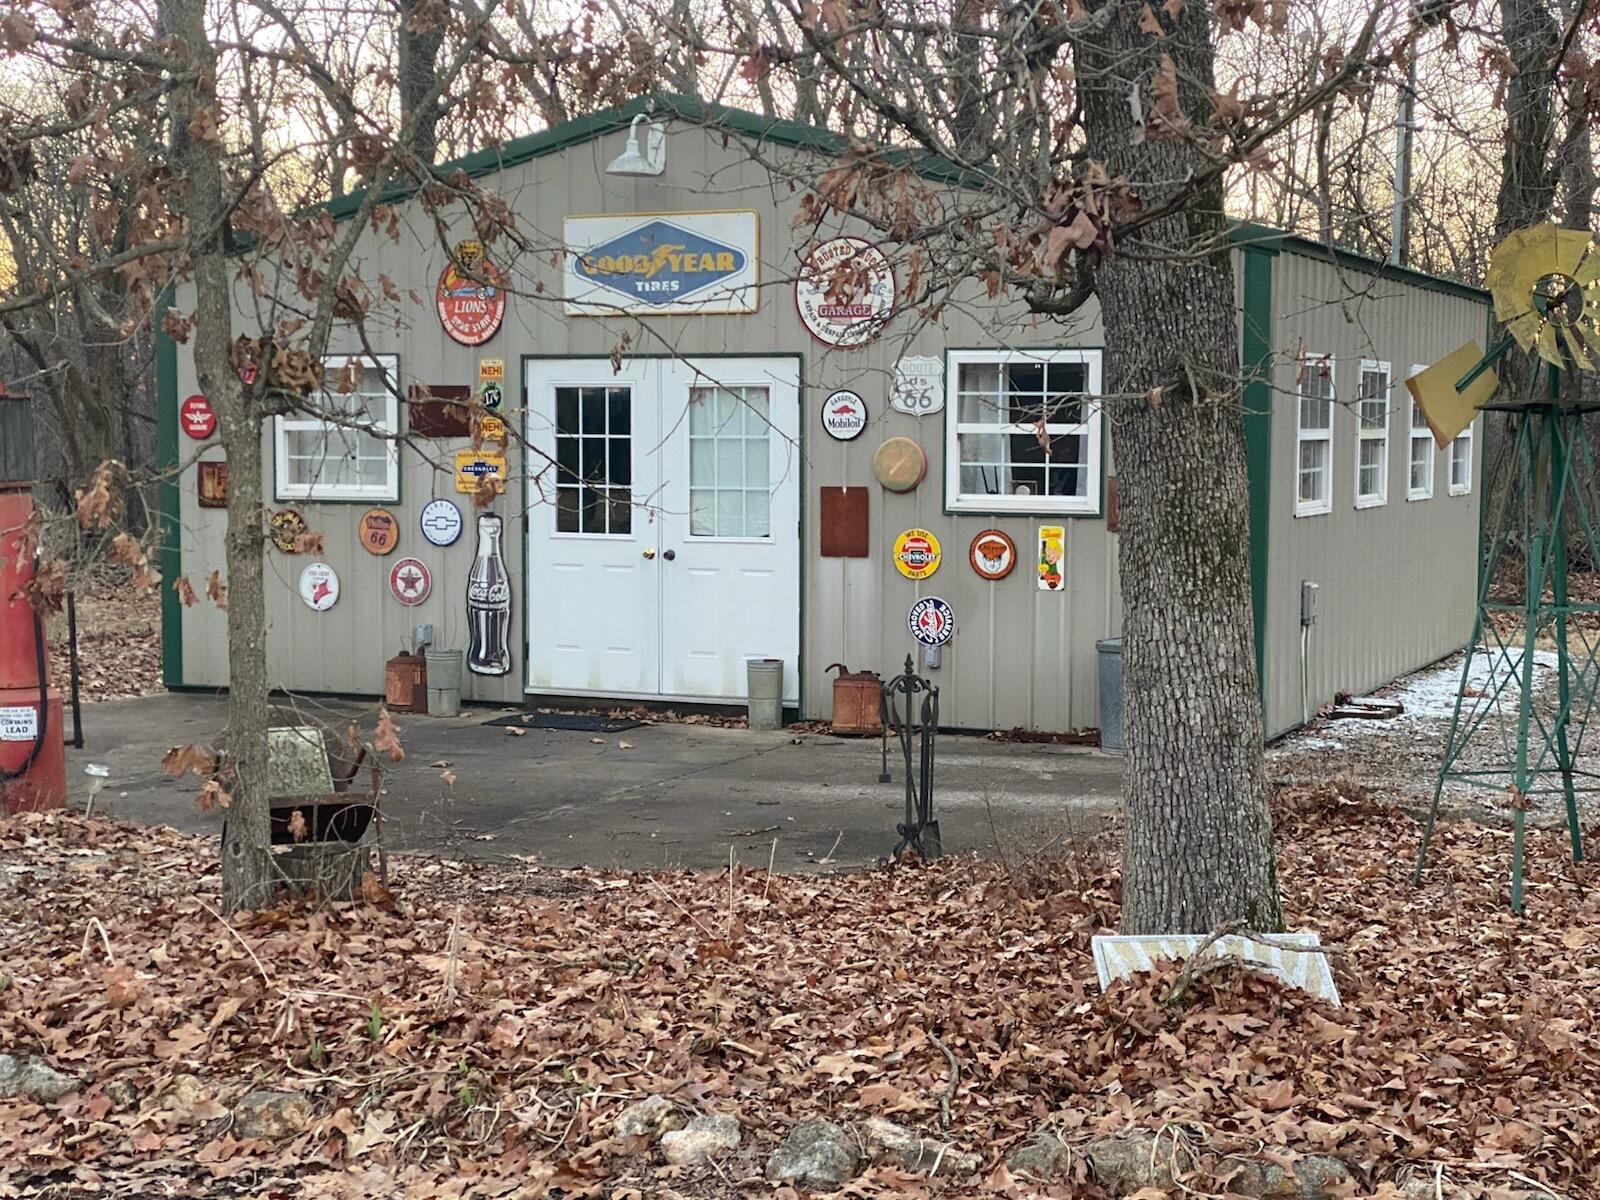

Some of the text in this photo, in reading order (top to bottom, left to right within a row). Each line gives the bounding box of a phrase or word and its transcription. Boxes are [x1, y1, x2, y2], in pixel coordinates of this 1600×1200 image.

[818, 245, 852, 266] BUSTED
[635, 280, 680, 292] TIRES
[454, 300, 487, 313] LIONS
[804, 300, 818, 322] REPAIR
[819, 305, 871, 316] GARAGE
[481, 366, 503, 375] NEHI
[902, 363, 936, 373] ROUTE
[830, 395, 858, 406] GARGOYLE
[903, 386, 934, 408] 66
[482, 421, 503, 431] NEHI
[828, 417, 861, 429] Mobiloil
[370, 531, 388, 546] 66
[905, 529, 916, 538] WE
[899, 552, 937, 561] CHEVROLET
[907, 569, 927, 578] PARTS
[911, 602, 926, 639] APPROVED
[939, 604, 953, 641] SERVICE
